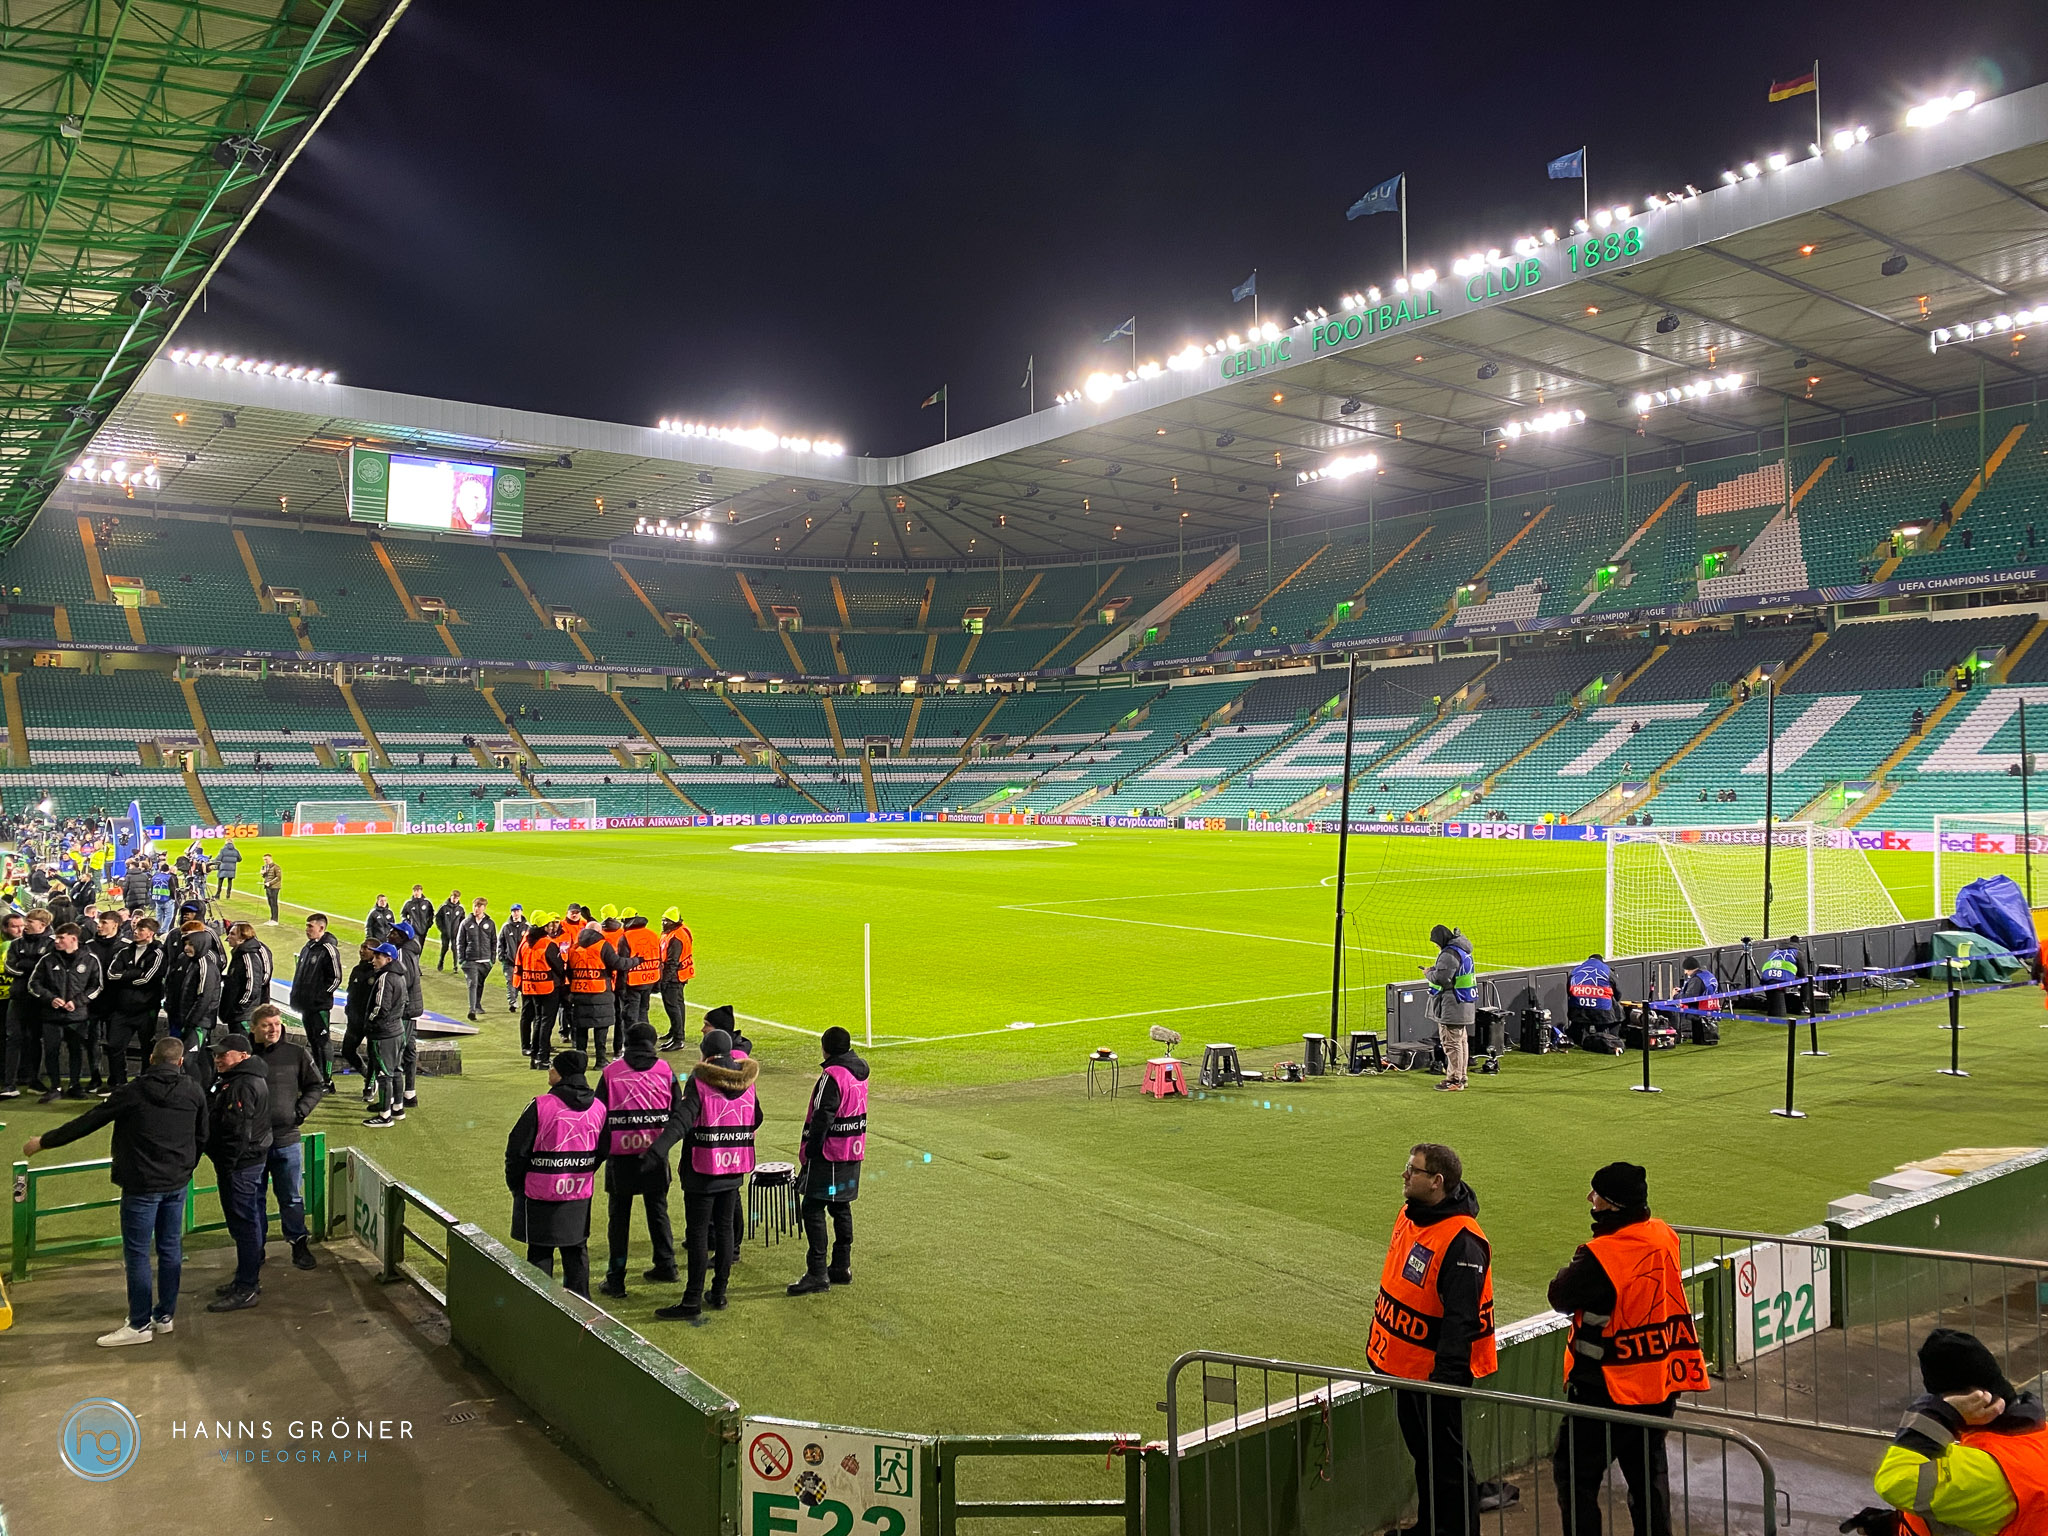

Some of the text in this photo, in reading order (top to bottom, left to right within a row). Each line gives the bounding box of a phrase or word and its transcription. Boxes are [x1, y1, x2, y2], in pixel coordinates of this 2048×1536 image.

[1221, 227, 1642, 379] CELTIC FOOTBALL CLUB 1888
[1899, 569, 2037, 592] UEFA CHAMPIONS LEAGUE
[1589, 612, 1634, 622] CHAMPION
[76, 643, 113, 651] CHAMPIONS
[1332, 634, 1404, 649] UEFA CHAMPIONS LEAGUE
[1165, 657, 1188, 667] CHAMPIONS
[1189, 655, 1207, 664] LEAGUE
[595, 665, 629, 673] CHAMPIONS
[610, 818, 645, 828] QATAR
[648, 817, 690, 827] AIRWAYS
[713, 815, 755, 826] PEPSI
[790, 813, 845, 824] crypto.com
[879, 813, 905, 821] PS5
[948, 814, 984, 822] mastercard
[1040, 815, 1092, 825] QATAR AIRWAYS
[1118, 817, 1167, 828] crypto.com
[406, 821, 473, 833] Heineken
[551, 818, 586, 831] FedEx
[1184, 817, 1226, 830] bet365
[1247, 819, 1304, 833] Heineken
[190, 824, 259, 839] bet365
[1355, 824, 1399, 833] CHAMPIONS
[1400, 825, 1430, 835] LEAGUE
[1468, 823, 1525, 840] PEPSI
[1851, 830, 1912, 850] FedEx
[1573, 987, 1604, 996] PHOTO
[1579, 998, 1597, 1007] 015
[628, 1115, 643, 1124] FAN
[830, 1121, 858, 1132] VISITING
[694, 1132, 719, 1142] VISITING
[720, 1132, 735, 1141] FAN
[531, 1157, 563, 1168] VISITING
[563, 1158, 579, 1167] FAN
[715, 1151, 741, 1168] 004
[555, 1177, 586, 1195] 007
[354, 1194, 378, 1251] E24
[1754, 1284, 1815, 1350] E22
[1615, 1321, 1697, 1359] STEWA
